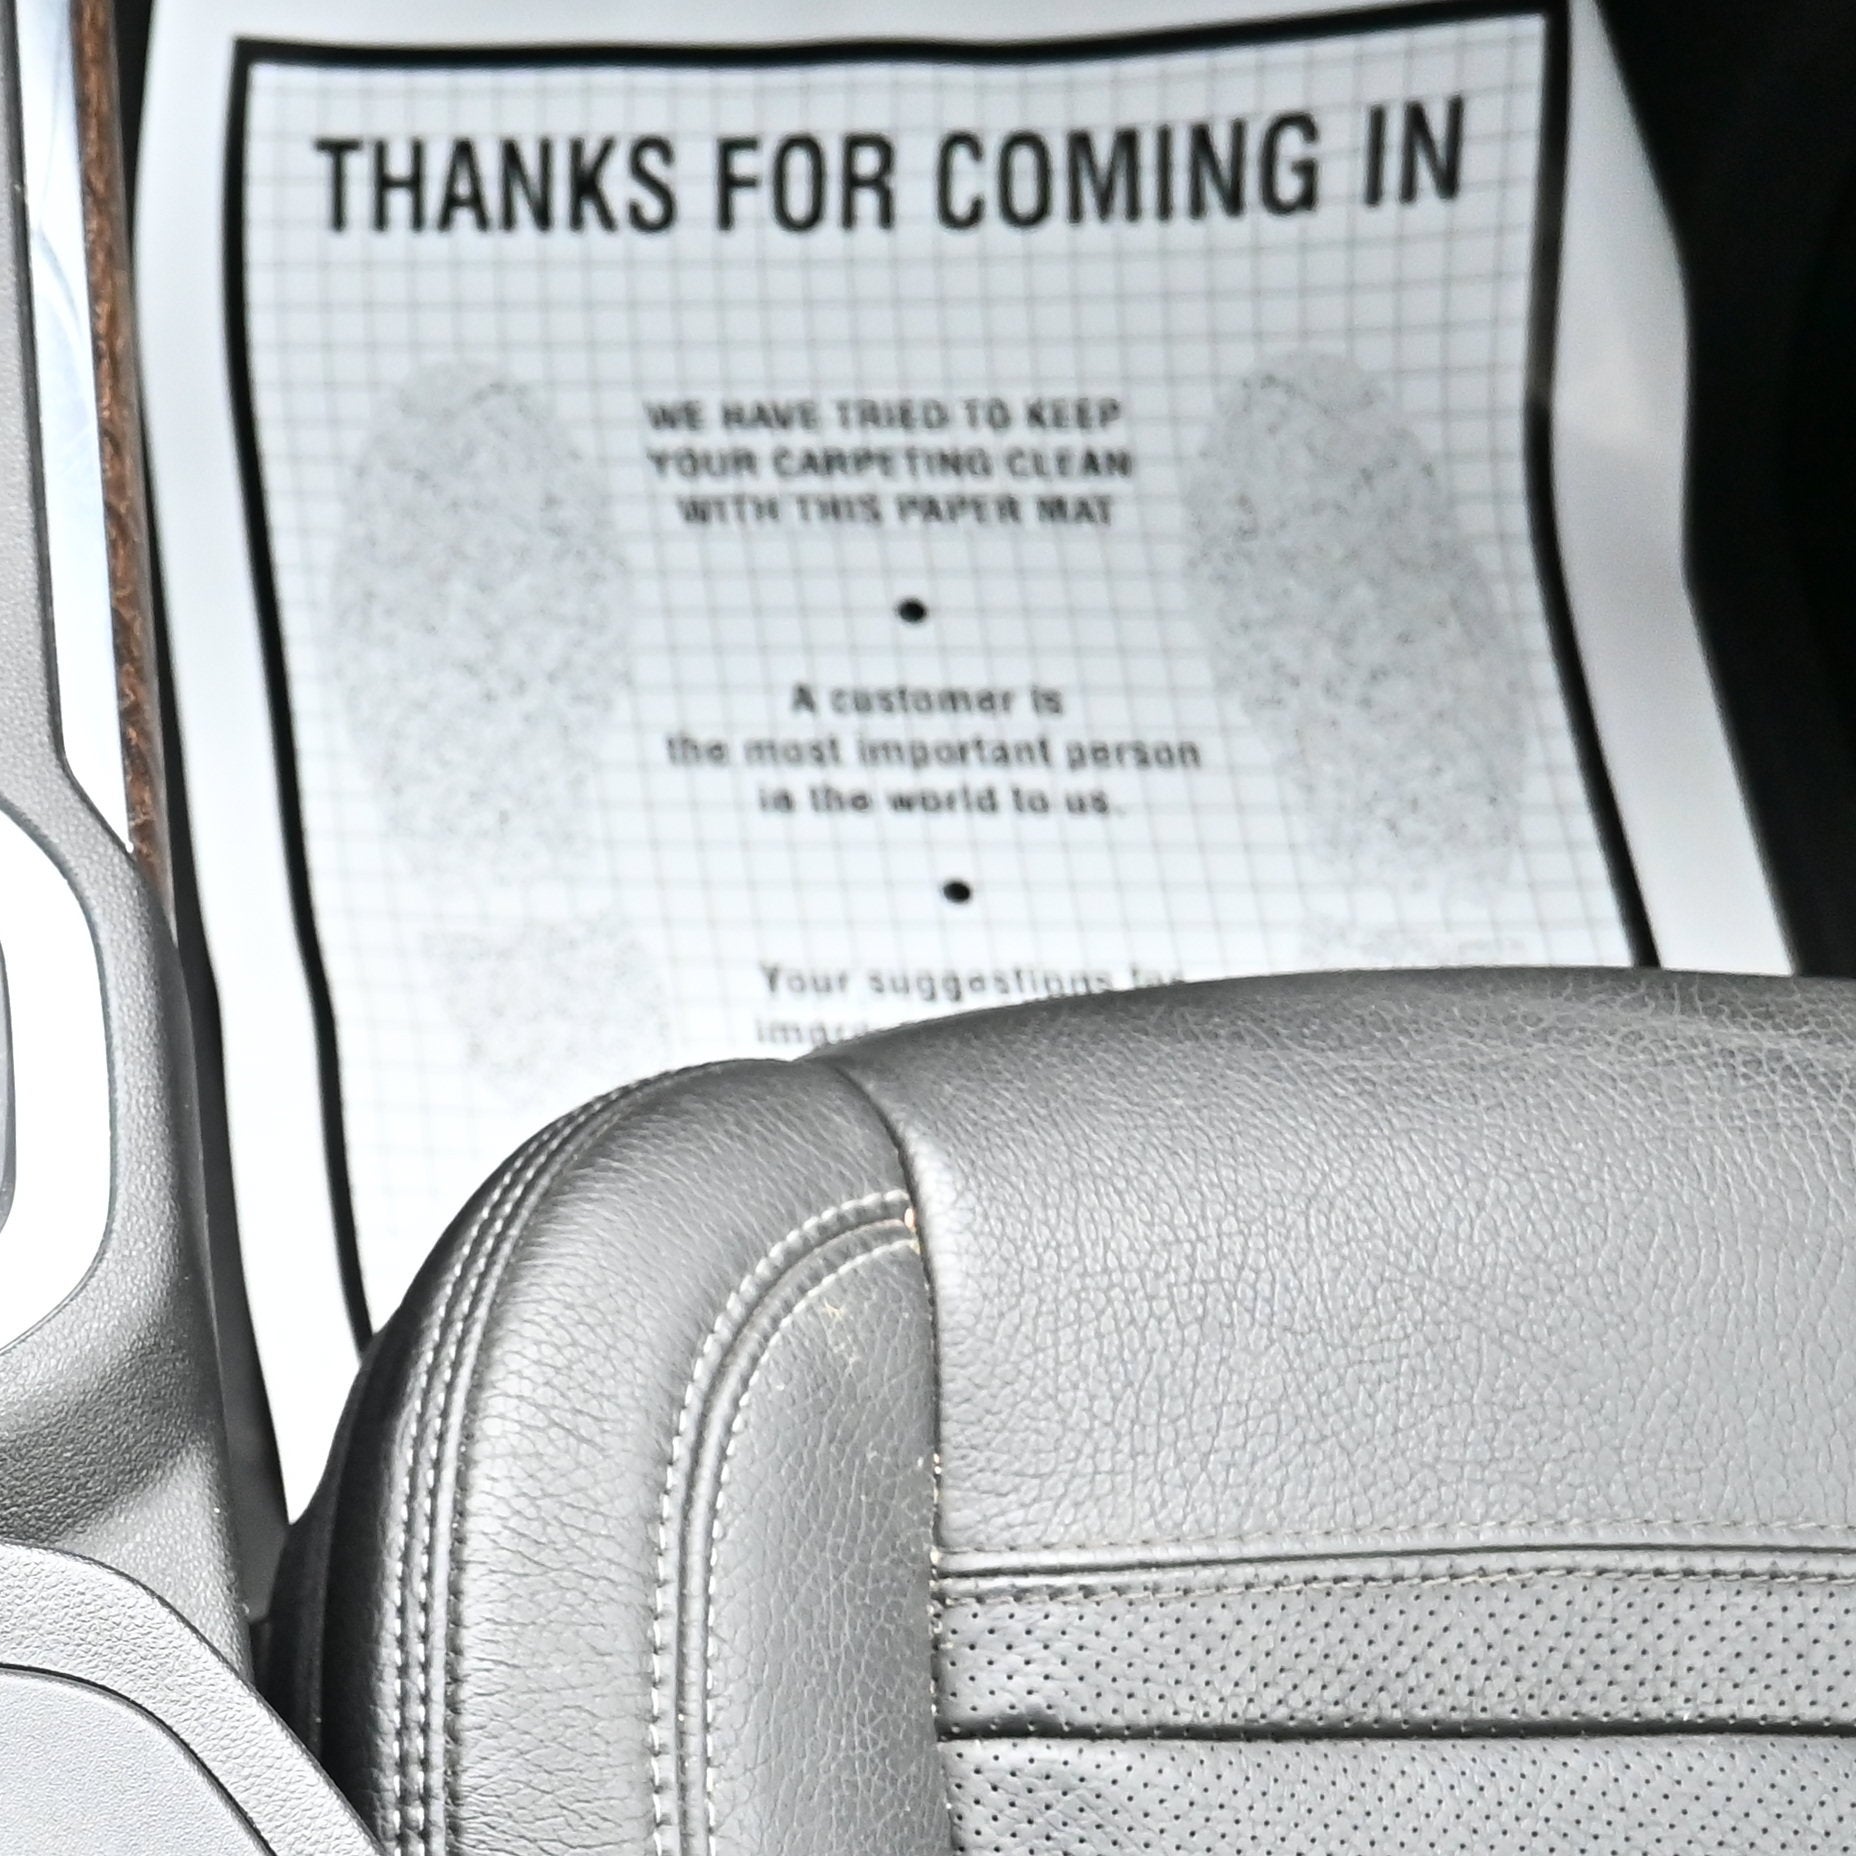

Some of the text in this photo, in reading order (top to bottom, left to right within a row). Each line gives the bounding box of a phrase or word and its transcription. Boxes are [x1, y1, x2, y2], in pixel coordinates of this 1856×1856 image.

[315, 95, 1468, 238] THANKS FOR COMING IN
[645, 398, 1122, 430] WE HAVE TRIED TO KEEP
[647, 446, 1133, 479] YOUR CARPETING CLEAN
[676, 494, 1113, 525] WITH THIS PAPER MAT
[792, 683, 1065, 717] A customer is
[666, 734, 1201, 771] the most important person
[809, 784, 872, 813] the
[887, 784, 999, 814] world
[1012, 785, 1051, 814] to
[760, 965, 849, 995] Your
[868, 965, 1114, 1002] suggestions
